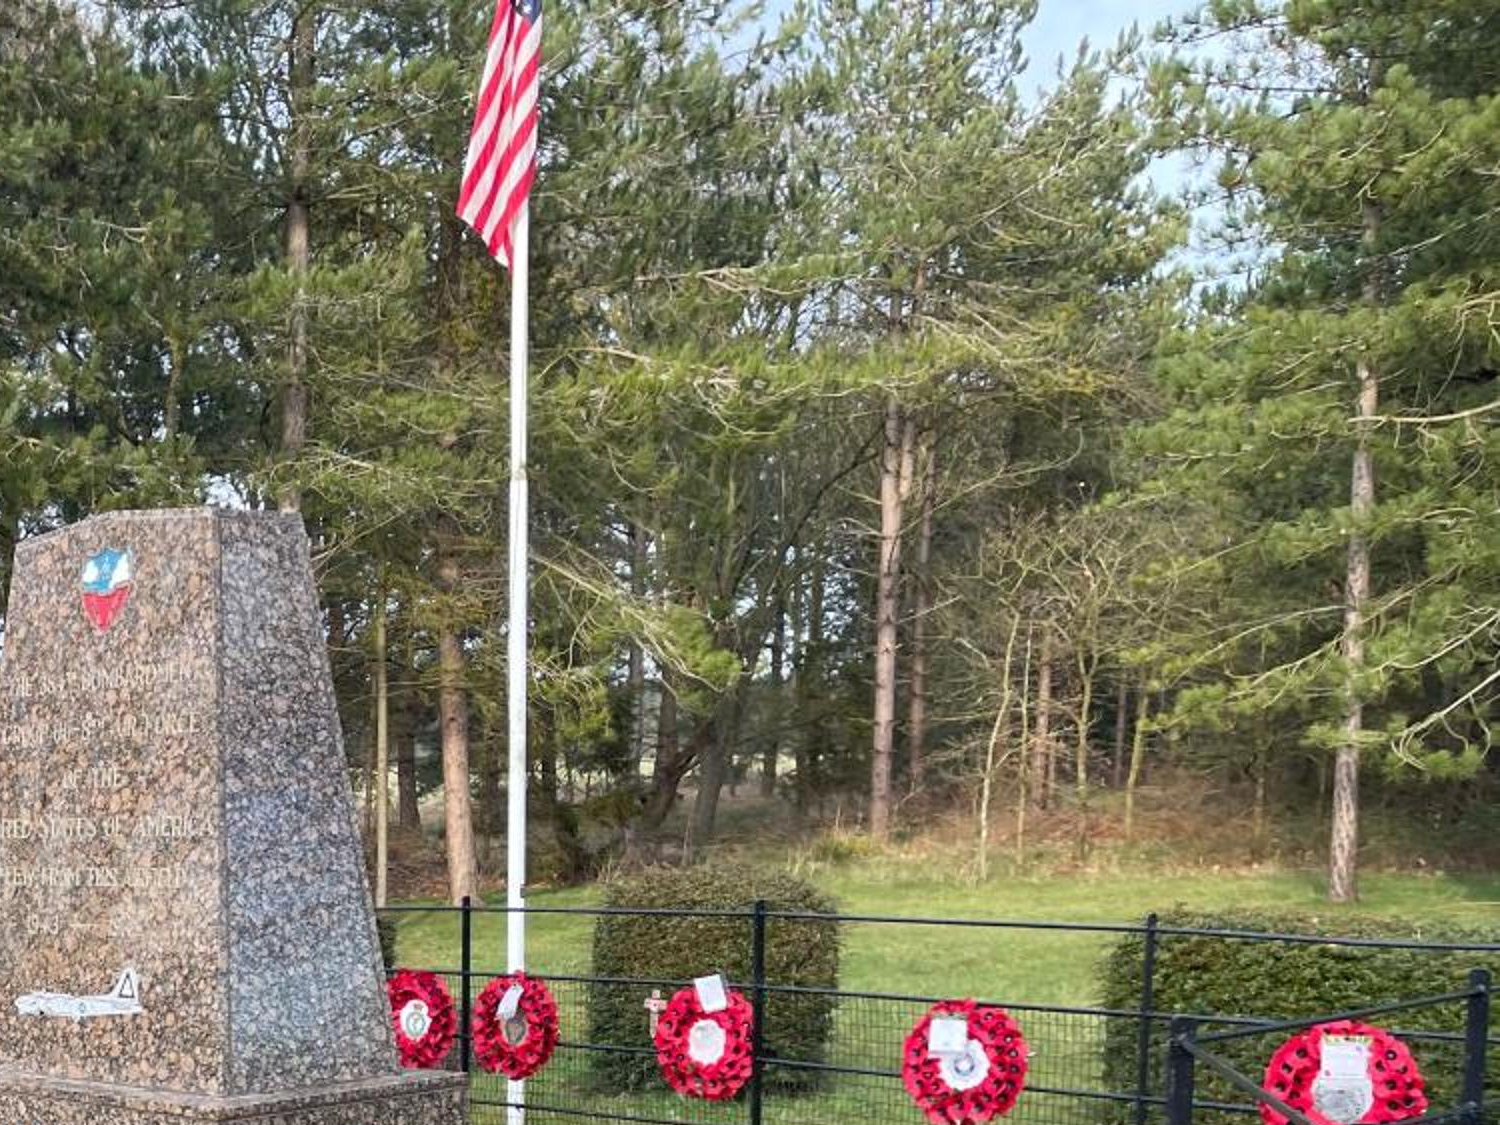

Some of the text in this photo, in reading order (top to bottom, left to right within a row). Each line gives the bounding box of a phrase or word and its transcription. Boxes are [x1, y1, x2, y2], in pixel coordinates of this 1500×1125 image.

[91, 767, 122, 788] THE
[38, 816, 98, 839] STATES
[105, 815, 120, 838] OF
[132, 814, 216, 838] AMERICA
